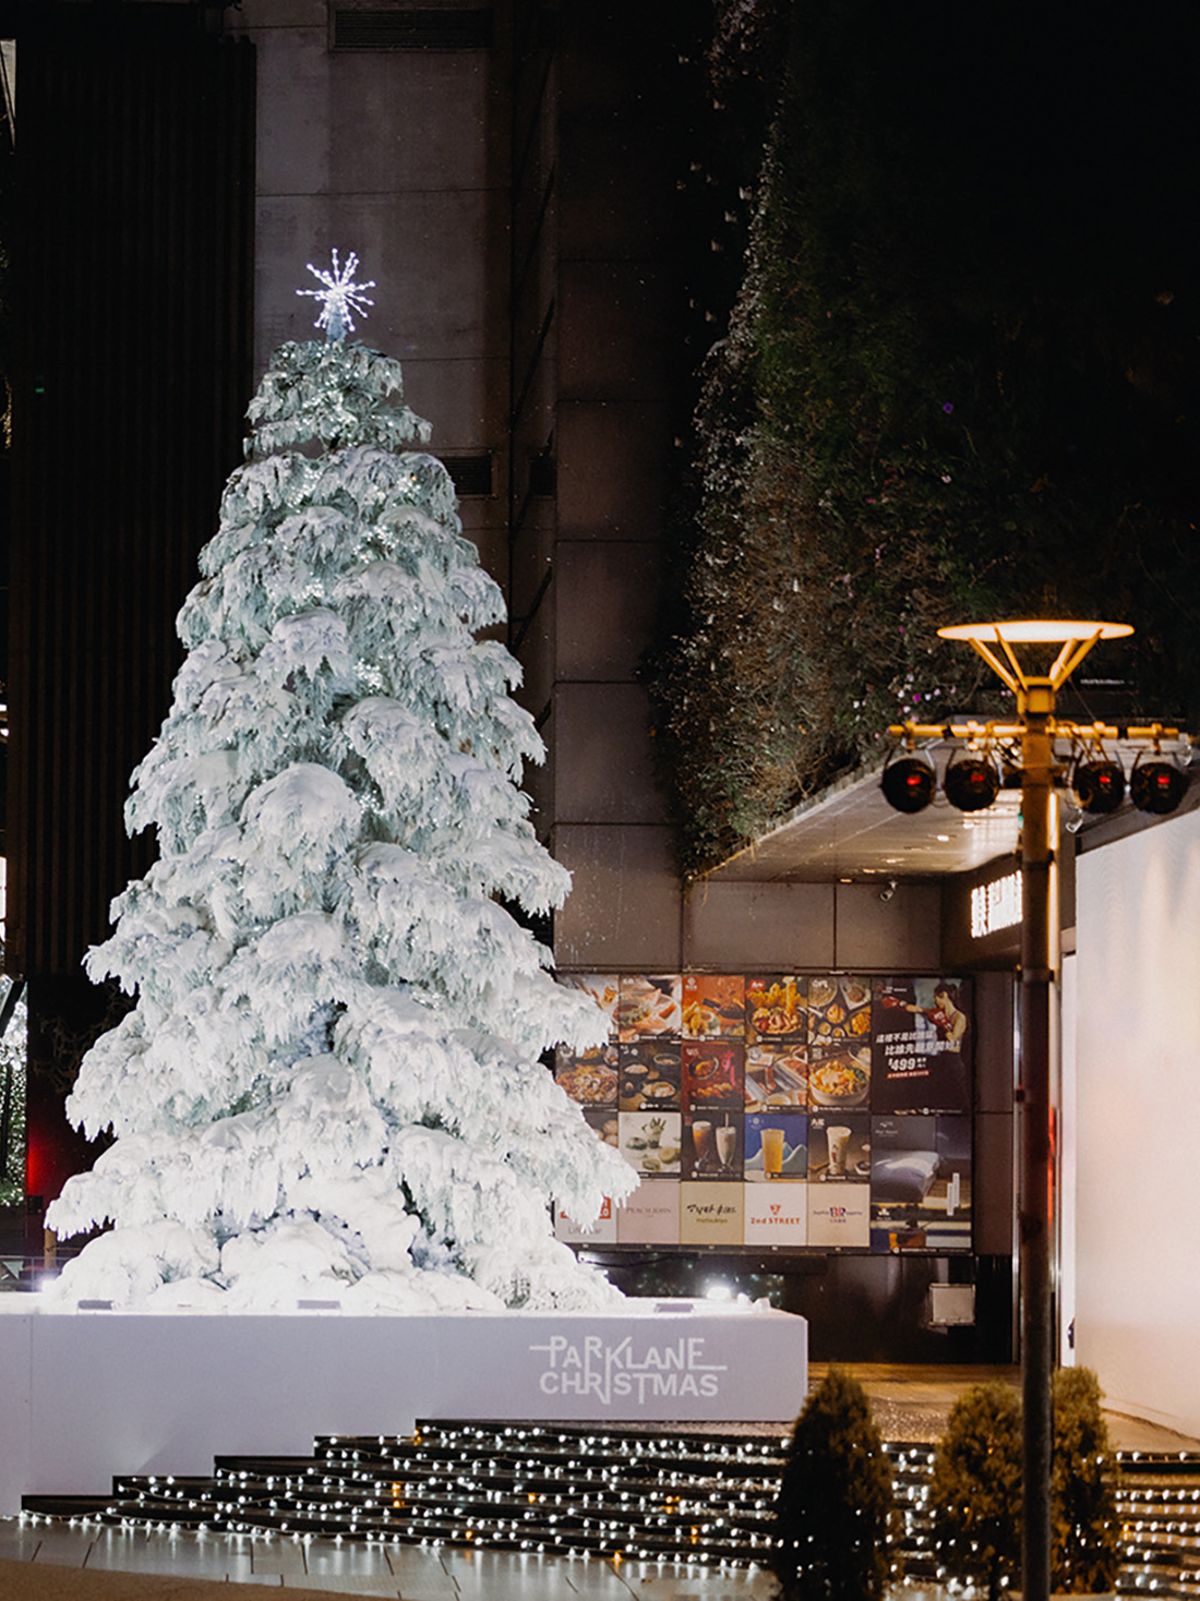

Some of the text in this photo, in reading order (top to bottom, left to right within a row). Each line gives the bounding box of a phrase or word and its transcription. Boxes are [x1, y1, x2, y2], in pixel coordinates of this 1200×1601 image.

[768, 1217, 800, 1225] STREET
[529, 1335, 727, 1371] PARKLANE
[539, 1370, 719, 1405] CHRISTMAS
